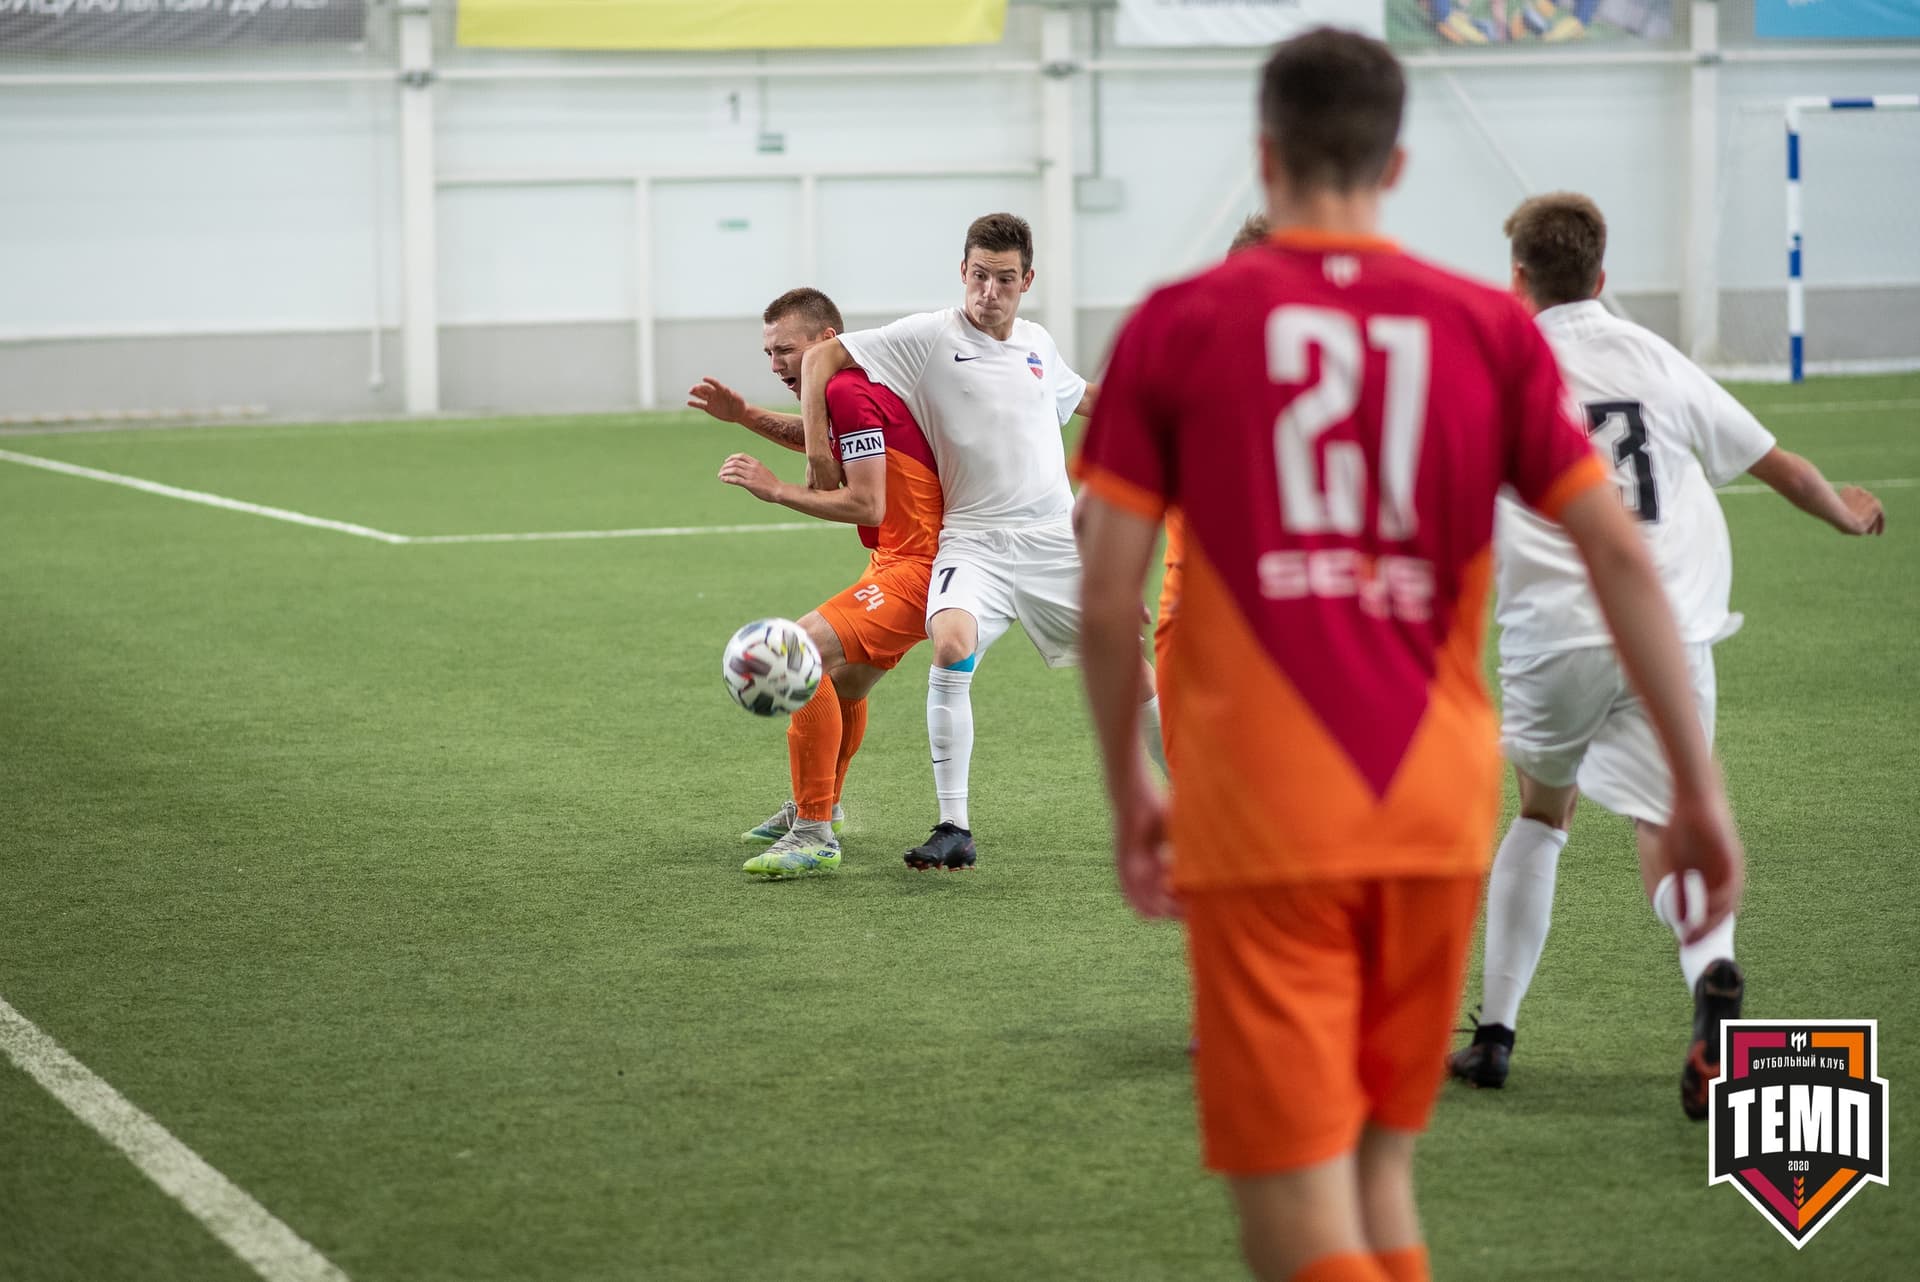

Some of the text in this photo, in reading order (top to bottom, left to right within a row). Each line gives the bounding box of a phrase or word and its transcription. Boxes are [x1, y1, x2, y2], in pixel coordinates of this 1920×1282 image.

[1264, 303, 1432, 541] 21
[1579, 401, 1660, 523] 3
[853, 584, 885, 612] 24
[939, 567, 958, 595] 7
